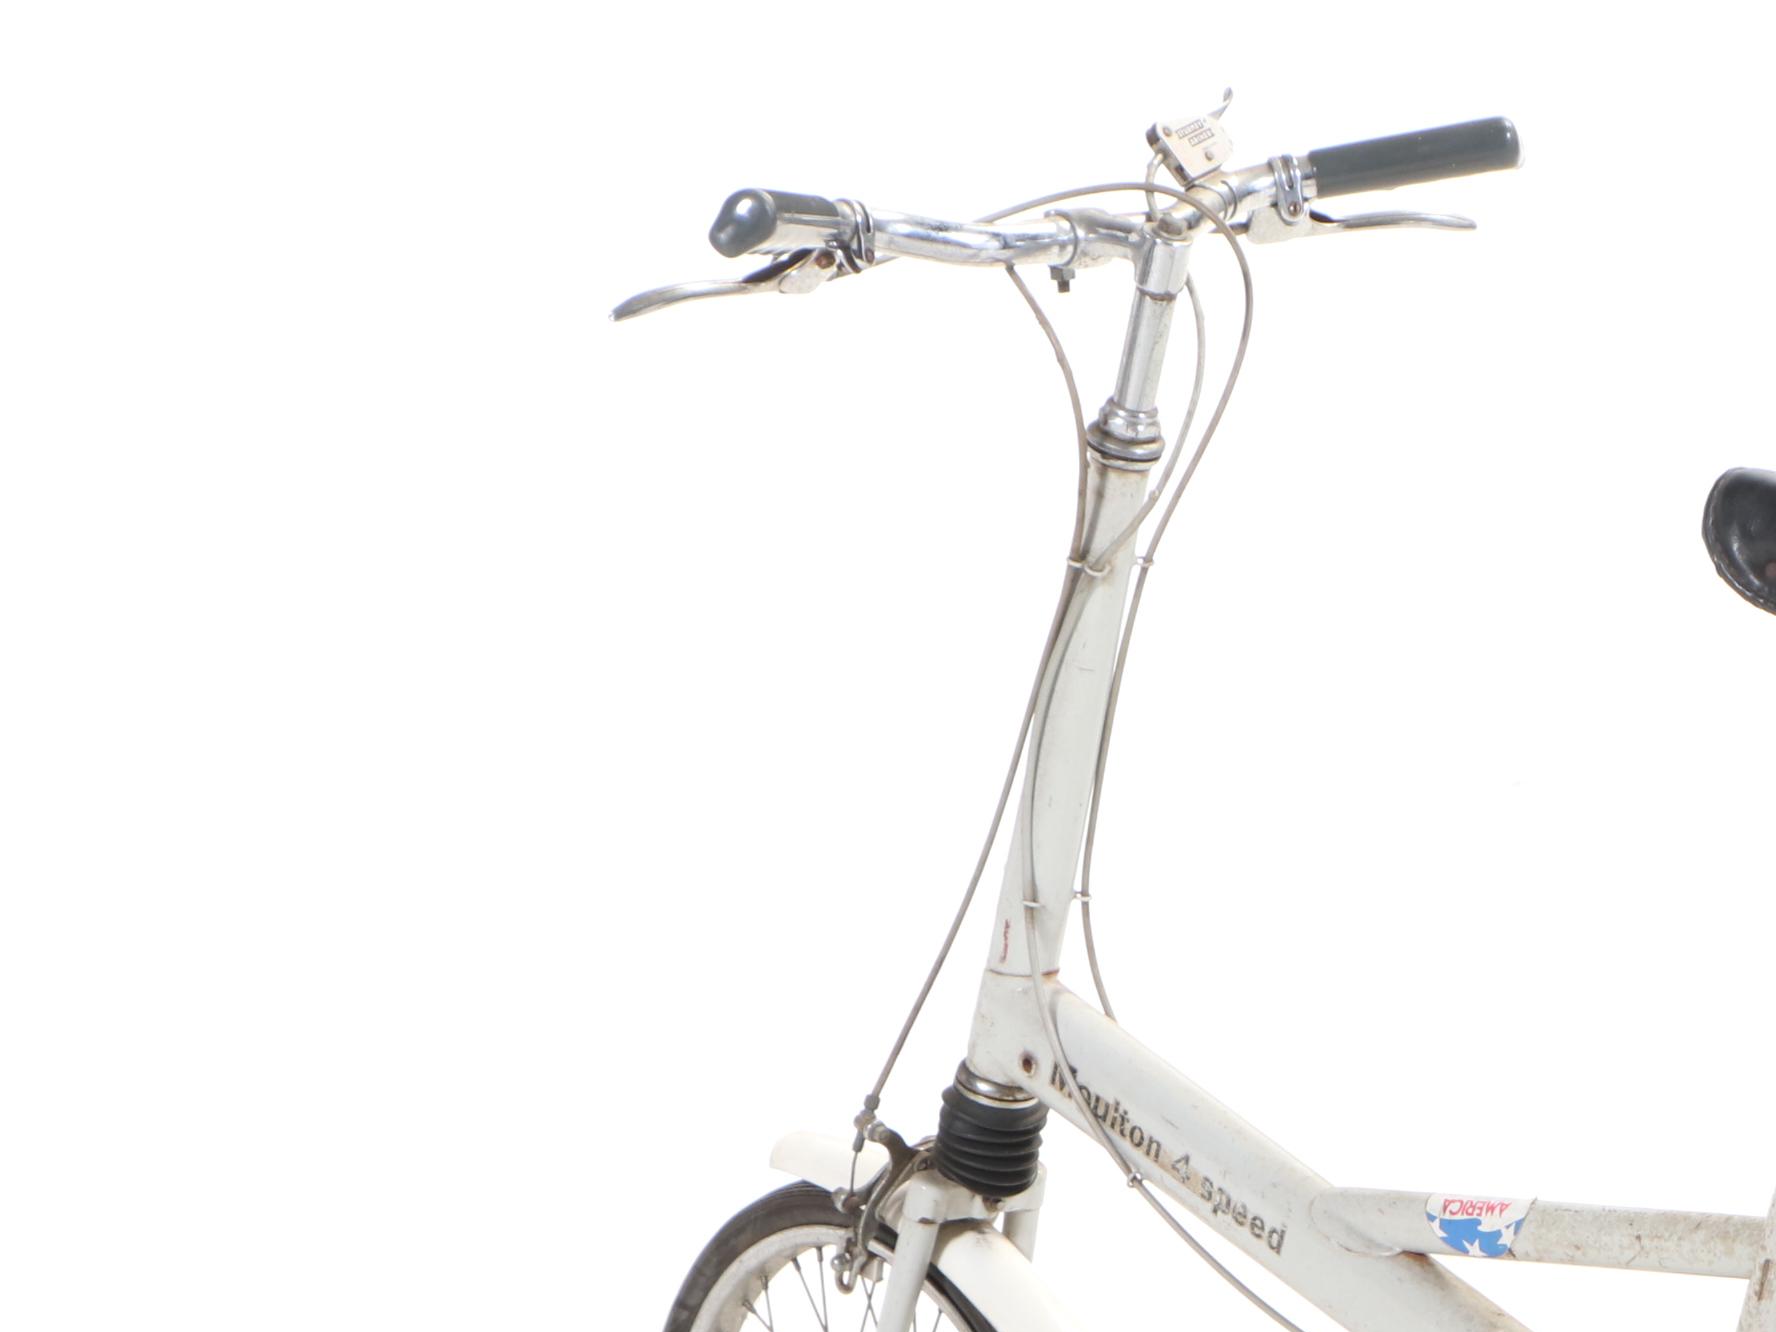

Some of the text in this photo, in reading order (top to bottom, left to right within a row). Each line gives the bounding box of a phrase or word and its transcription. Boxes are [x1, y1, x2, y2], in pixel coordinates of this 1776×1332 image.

[1171, 1153, 1192, 1184] 4
[1200, 1175, 1288, 1256] speed
[1442, 1199, 1512, 1217] AMERICA
